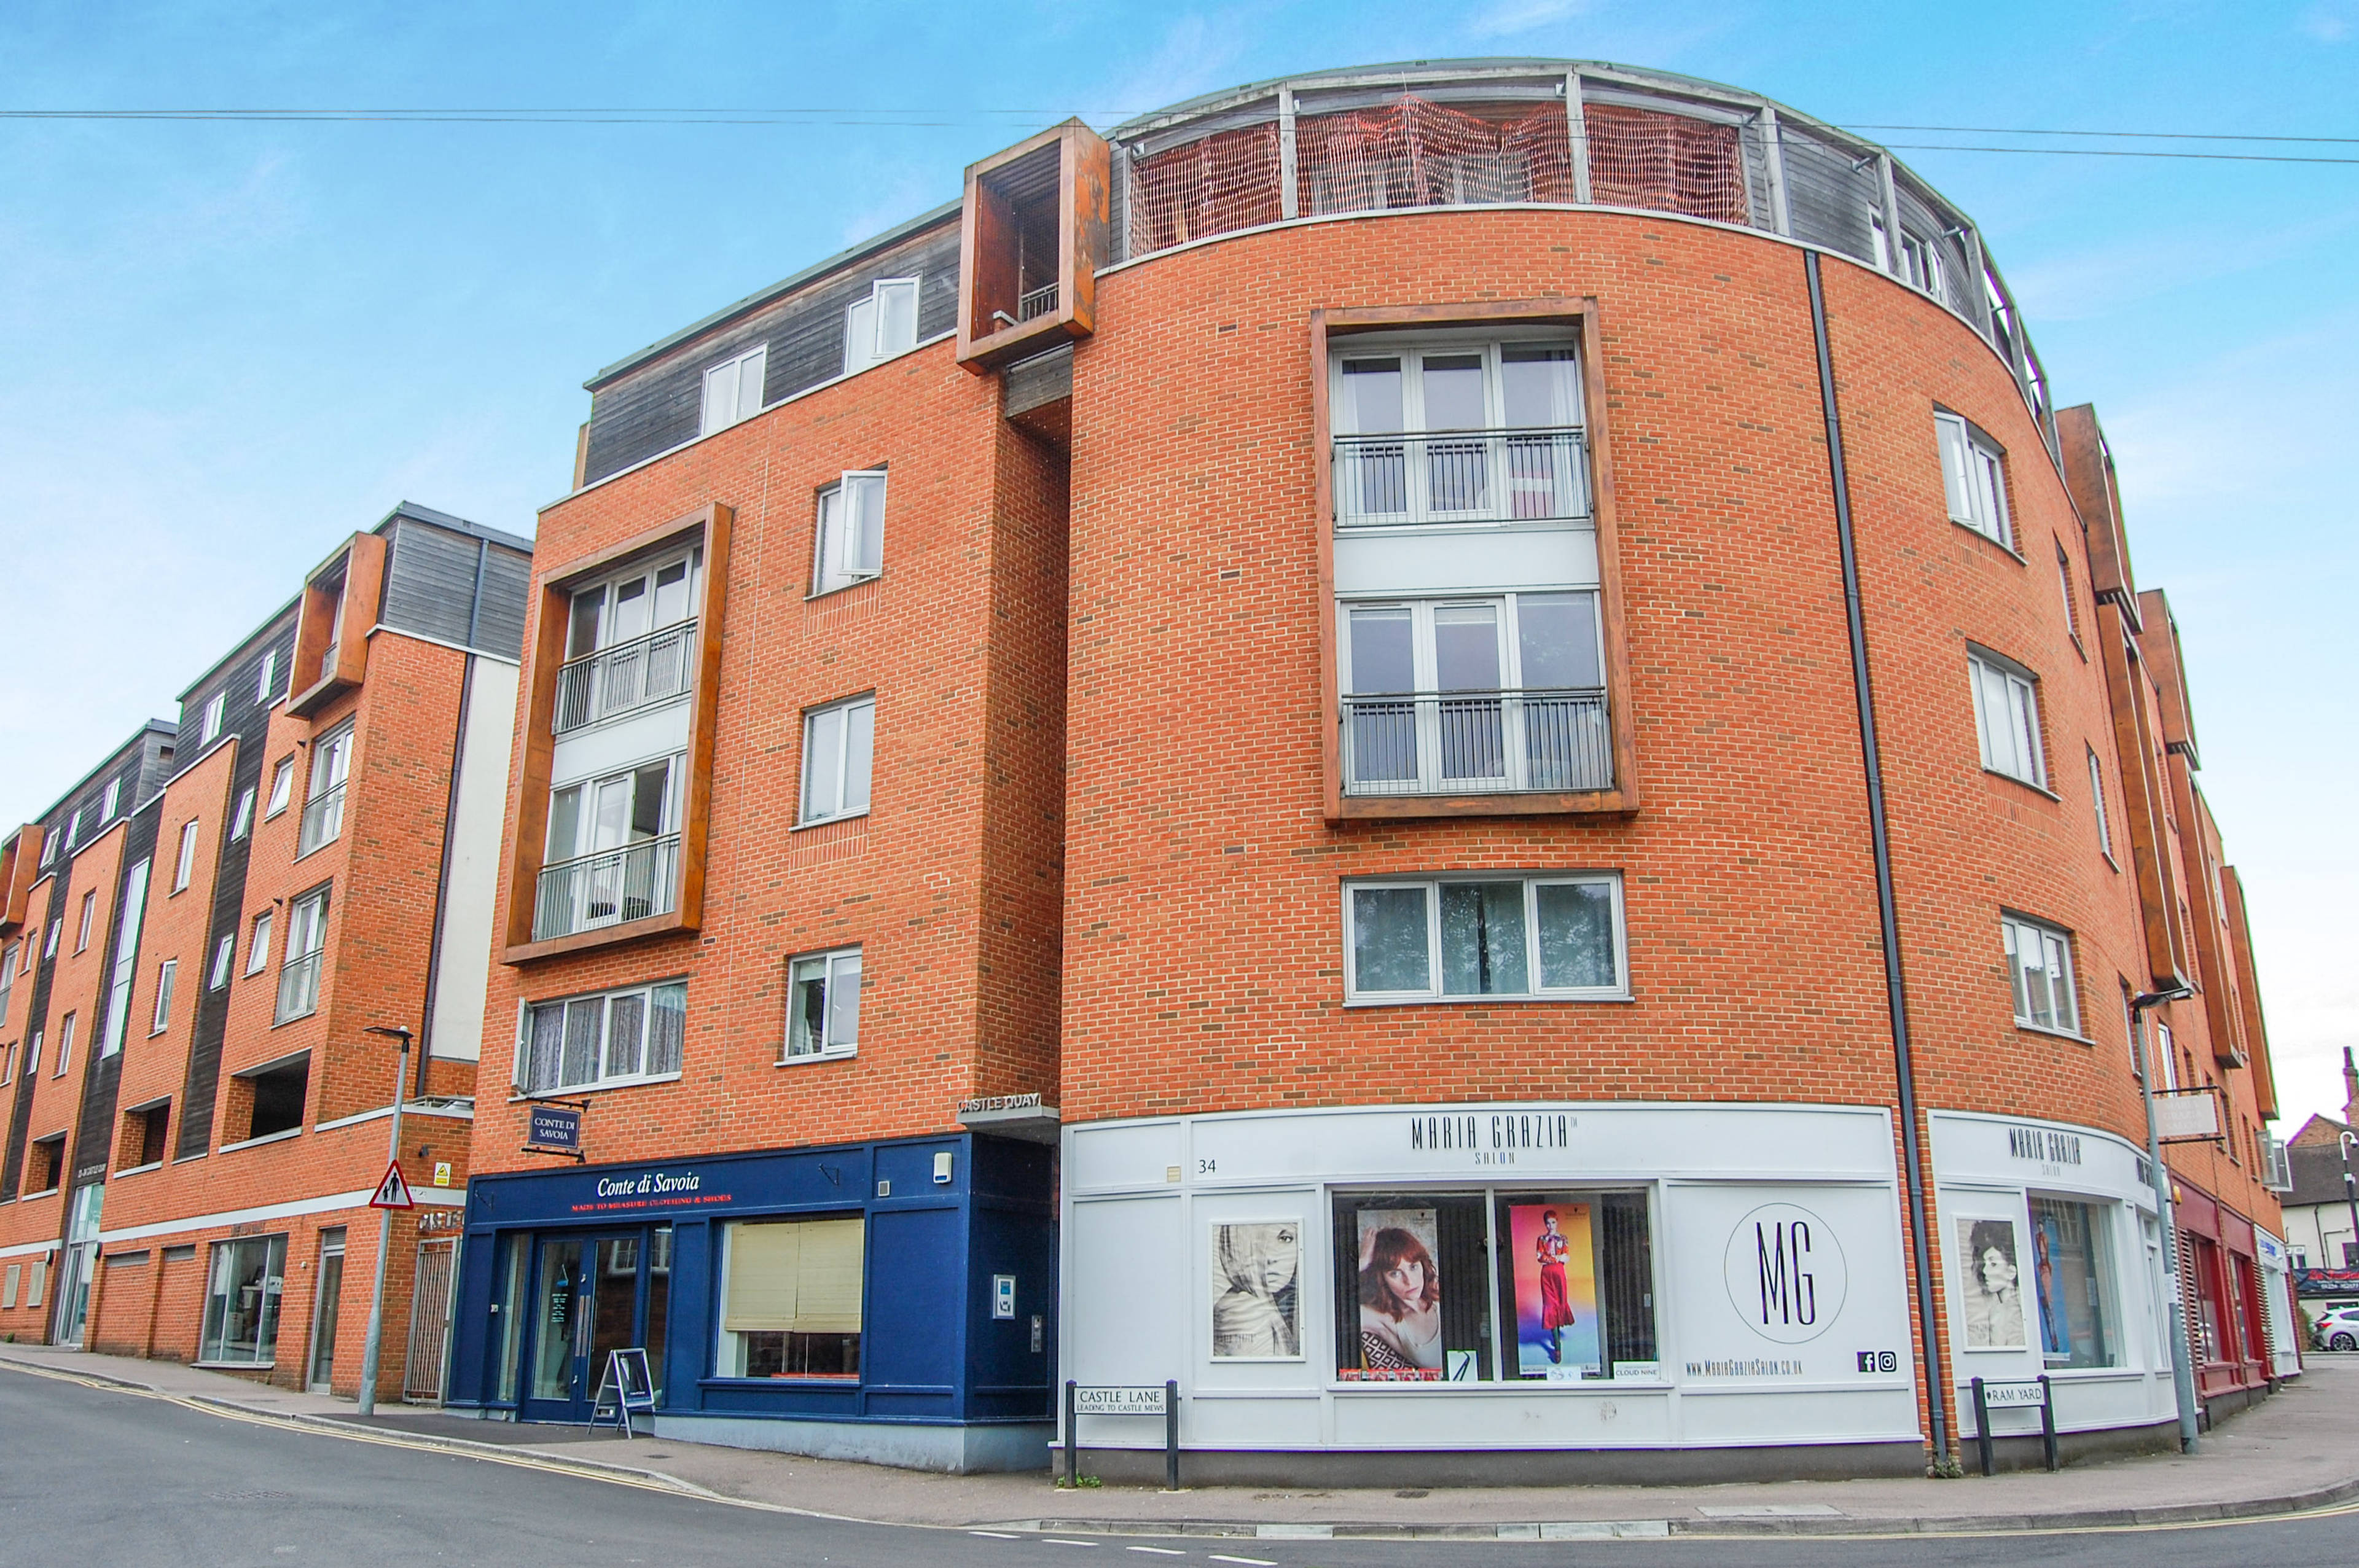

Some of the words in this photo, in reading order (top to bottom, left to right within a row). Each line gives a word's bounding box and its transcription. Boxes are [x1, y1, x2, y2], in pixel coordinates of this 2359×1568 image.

[957, 1097, 1003, 1113] CASTLE
[1003, 1093, 1040, 1109] QUAY
[534, 1117, 565, 1129] CONTE
[566, 1121, 575, 1130] DI
[539, 1129, 568, 1141] SAVOIA
[1412, 1115, 1476, 1149] MARIA
[1492, 1115, 1567, 1149] GRAZIA
[2009, 1128, 2044, 1160] MARIA
[2048, 1132, 2081, 1164] GRAZIA
[1475, 1152, 1515, 1164] SALON
[1199, 1159, 1216, 1173] 34
[597, 1177, 634, 1197] Conte
[637, 1174, 651, 1193] di
[654, 1171, 700, 1193] Savoia
[1756, 1221, 1816, 1325] MG
[1080, 1391, 1122, 1403] CASTLE
[1129, 1391, 1160, 1403] LANE
[1992, 1389, 2015, 1401] RAM
[2018, 1388, 2042, 1400] YARD
